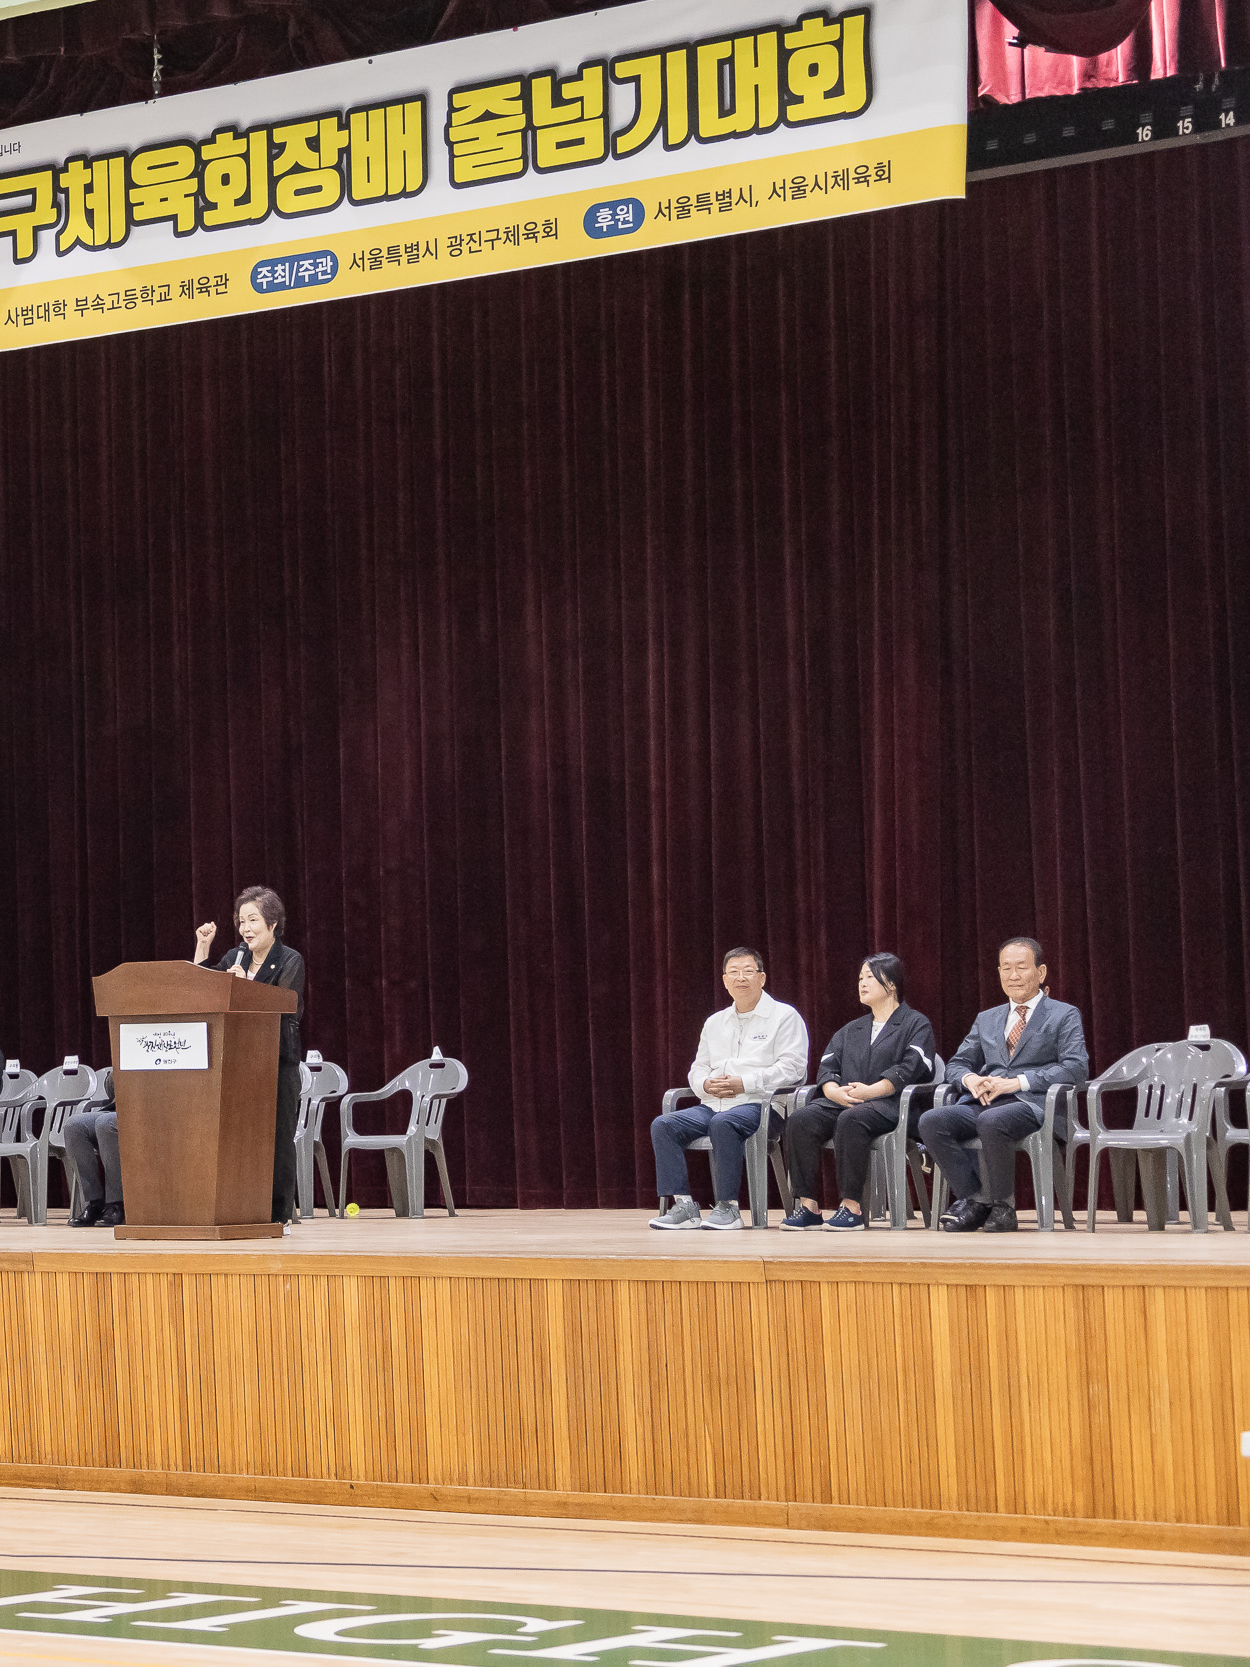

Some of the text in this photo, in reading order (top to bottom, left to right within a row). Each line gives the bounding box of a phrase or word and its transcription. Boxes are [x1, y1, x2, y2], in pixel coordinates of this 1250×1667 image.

[447, 11, 869, 188] 줄넘기대회
[1136, 111, 1235, 142] 16 15 14
[3, 297, 68, 329] 사범대학
[73, 284, 172, 318] 부속고등학교
[178, 273, 230, 300] 체육관
[256, 255, 333, 290] 주최/주관
[348, 237, 439, 273] 서울특별시
[446, 217, 559, 257] 광진구체육회
[594, 203, 634, 232] 후원
[653, 184, 760, 222] 서울특별시,
[767, 159, 893, 201] 서울시체육회
